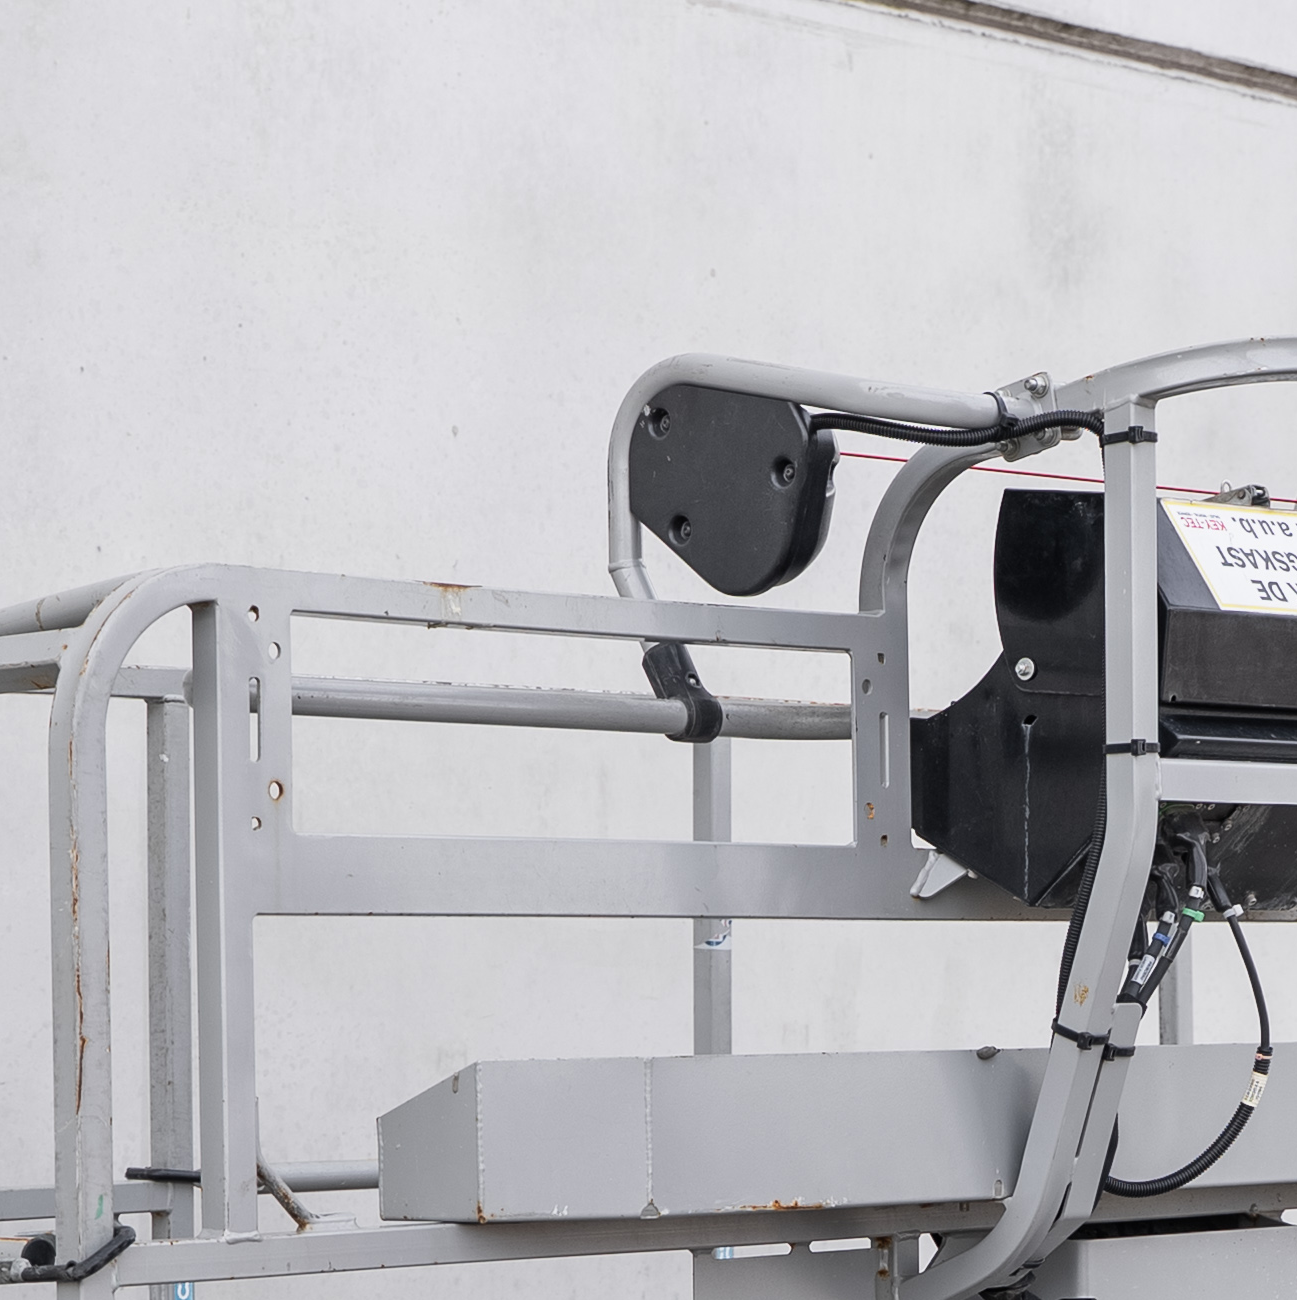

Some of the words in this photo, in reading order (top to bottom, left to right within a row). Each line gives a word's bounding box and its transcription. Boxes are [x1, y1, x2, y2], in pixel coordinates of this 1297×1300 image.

[1180, 516, 1228, 531] KEY-TEC
[1231, 516, 1293, 539] a.u.b.
[1252, 579, 1289, 602] DE
